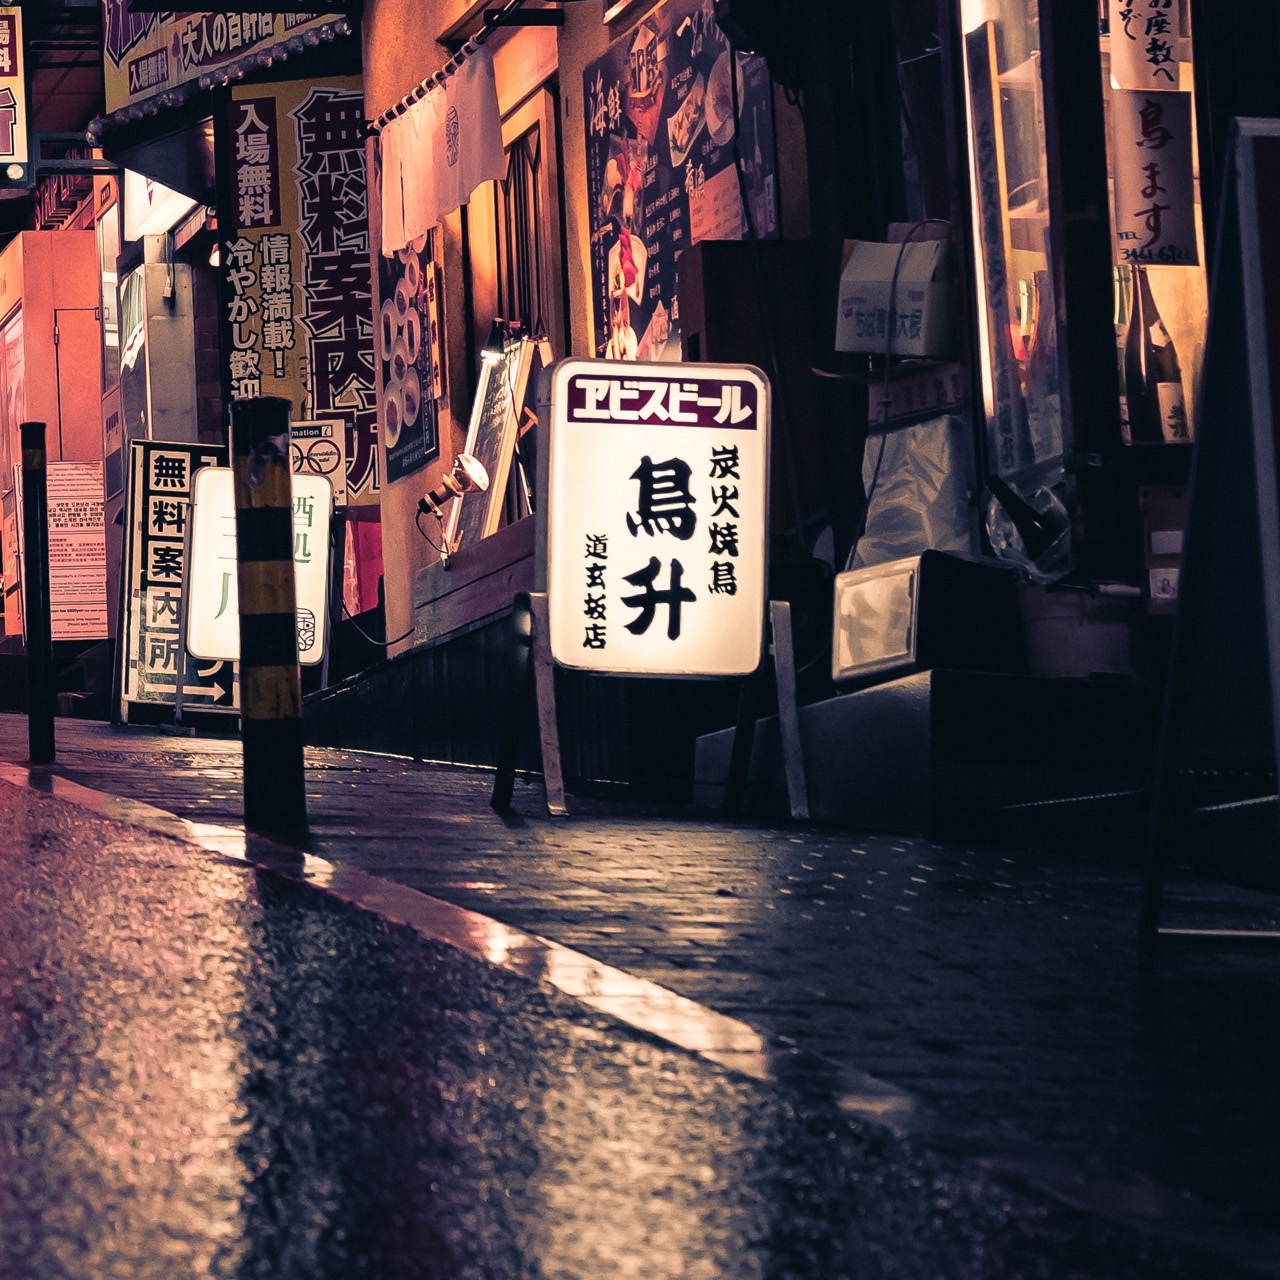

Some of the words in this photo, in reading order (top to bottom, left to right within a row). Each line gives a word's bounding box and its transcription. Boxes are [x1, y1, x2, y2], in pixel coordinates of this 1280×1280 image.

[235, 104, 274, 226] 入場無料
[622, 455, 698, 642] 鳥升
[707, 446, 742, 597] 炭火焼鳥
[581, 531, 611, 651] 道玄坂店
